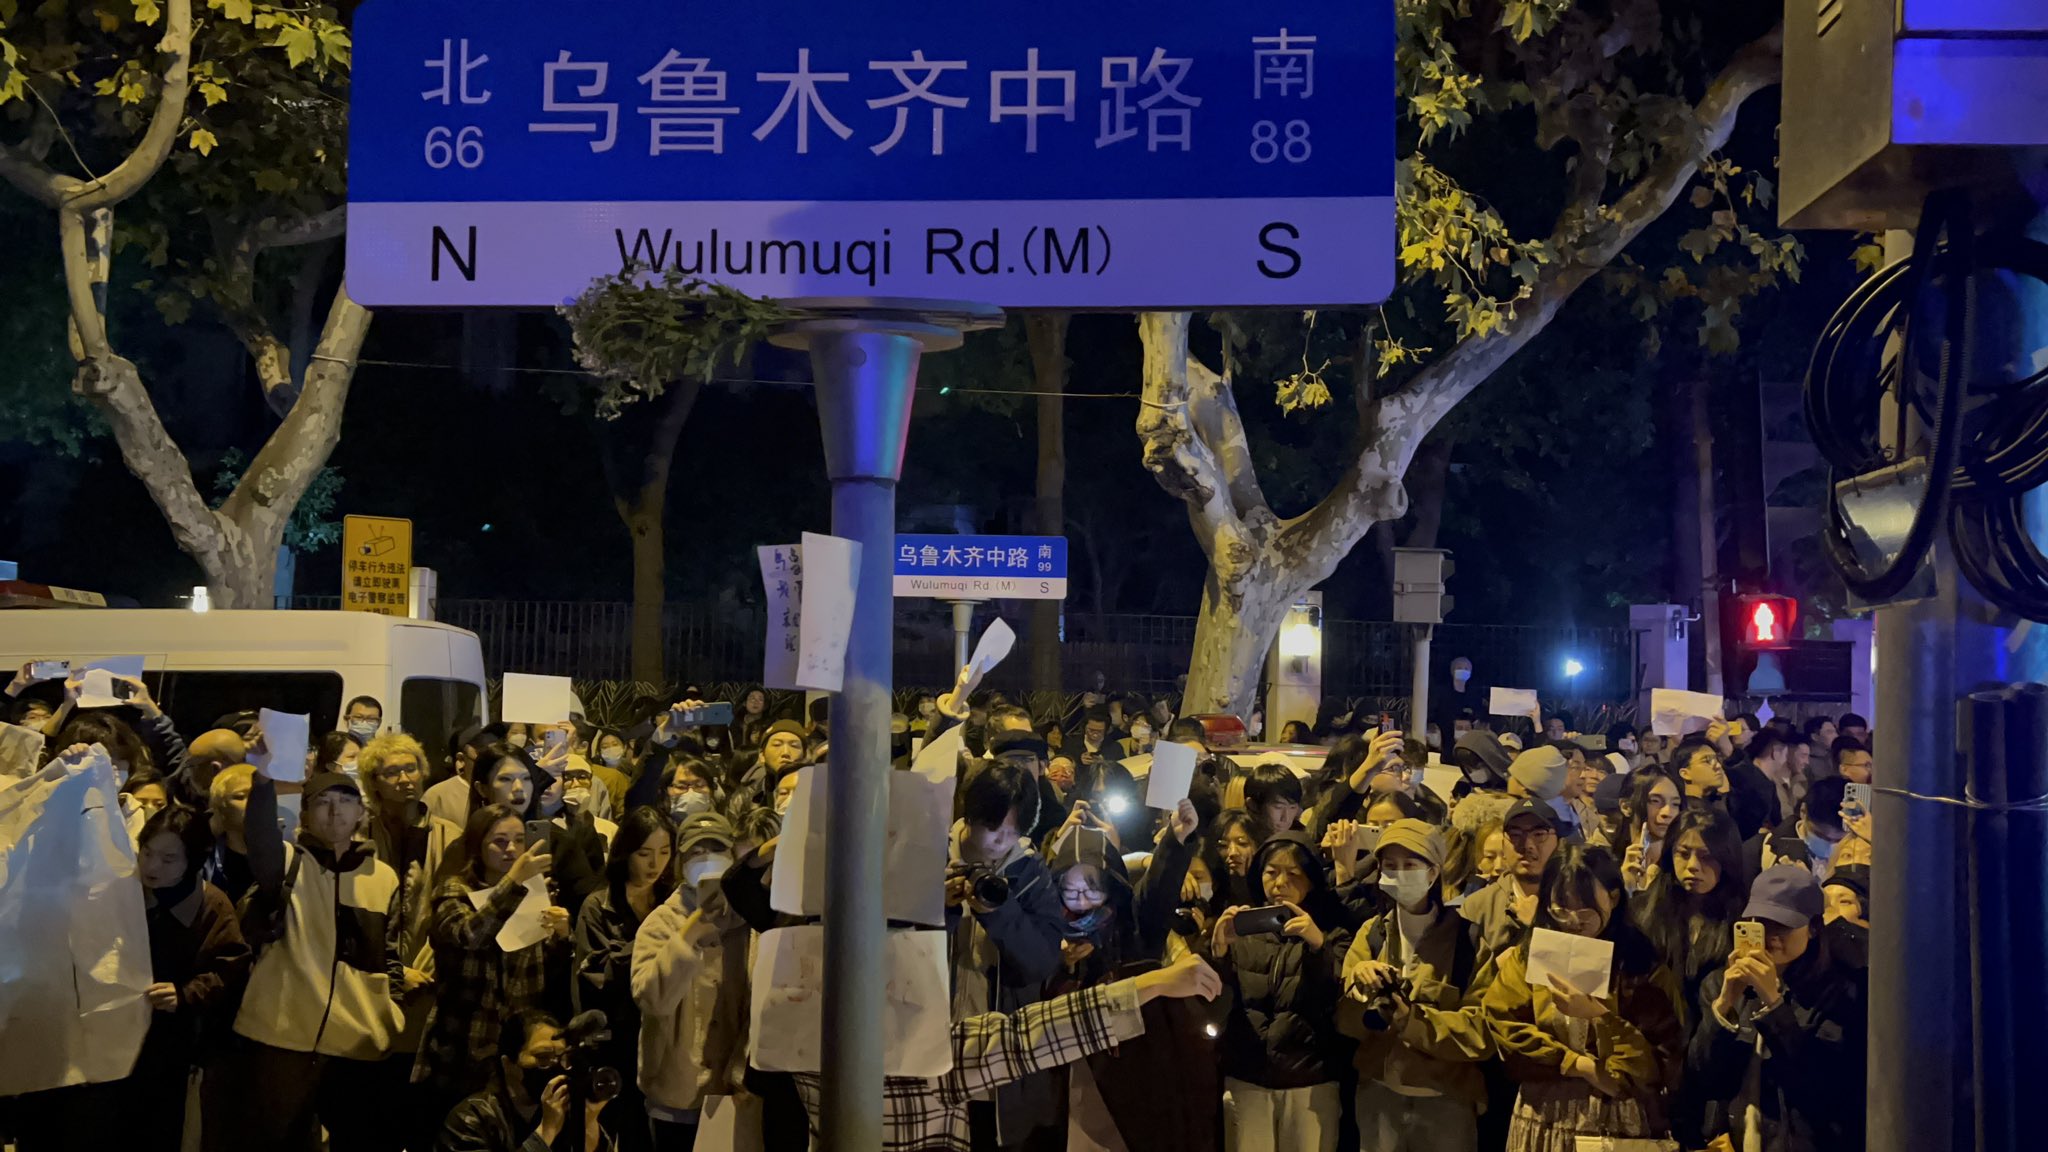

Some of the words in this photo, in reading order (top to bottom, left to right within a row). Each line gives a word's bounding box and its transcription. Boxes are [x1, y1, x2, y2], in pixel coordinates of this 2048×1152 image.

[422, 38, 491, 105] 北
[1252, 28, 1317, 99] 南
[528, 47, 1202, 156] 乌鲁木齐中路
[424, 125, 484, 168] 66
[1250, 119, 1312, 164] 88
[431, 226, 477, 281] N
[615, 228, 891, 287] Wulumuqi
[926, 225, 1111, 276] Rd.(M)
[1256, 222, 1302, 278] S
[898, 544, 1029, 568] 乌鲁木齐中路
[1037, 562, 1052, 572] 99
[1038, 544, 1052, 559] 南
[911, 579, 968, 590] Wulumuqi
[1040, 582, 1050, 593] S
